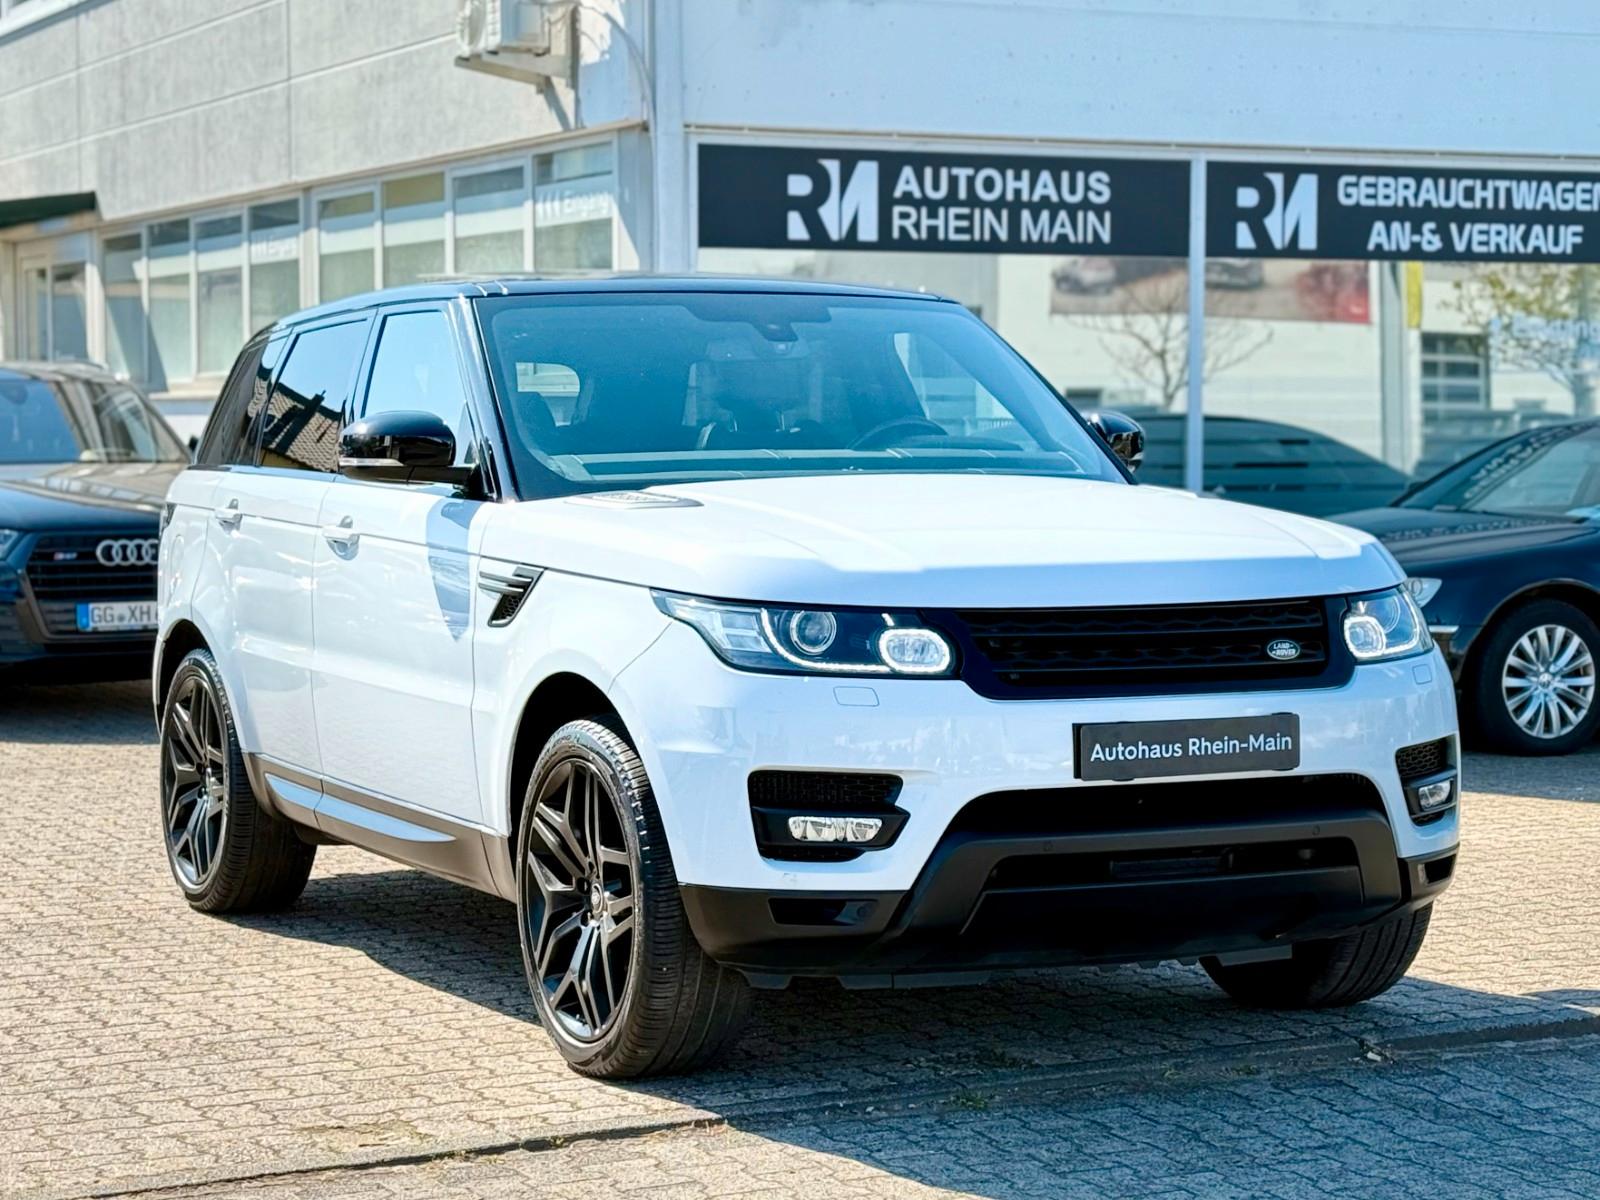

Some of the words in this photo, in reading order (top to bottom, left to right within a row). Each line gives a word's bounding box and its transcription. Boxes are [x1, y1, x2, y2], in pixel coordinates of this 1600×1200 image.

[893, 165, 1112, 204] AUTOHAUS
[892, 205, 1008, 243] RHEIN
[1020, 209, 1112, 245] MAIN
[1450, 222, 1584, 255] VERKAUF
[1090, 741, 1182, 762] Autohaus
[1188, 732, 1292, 756] Rhein-Main
